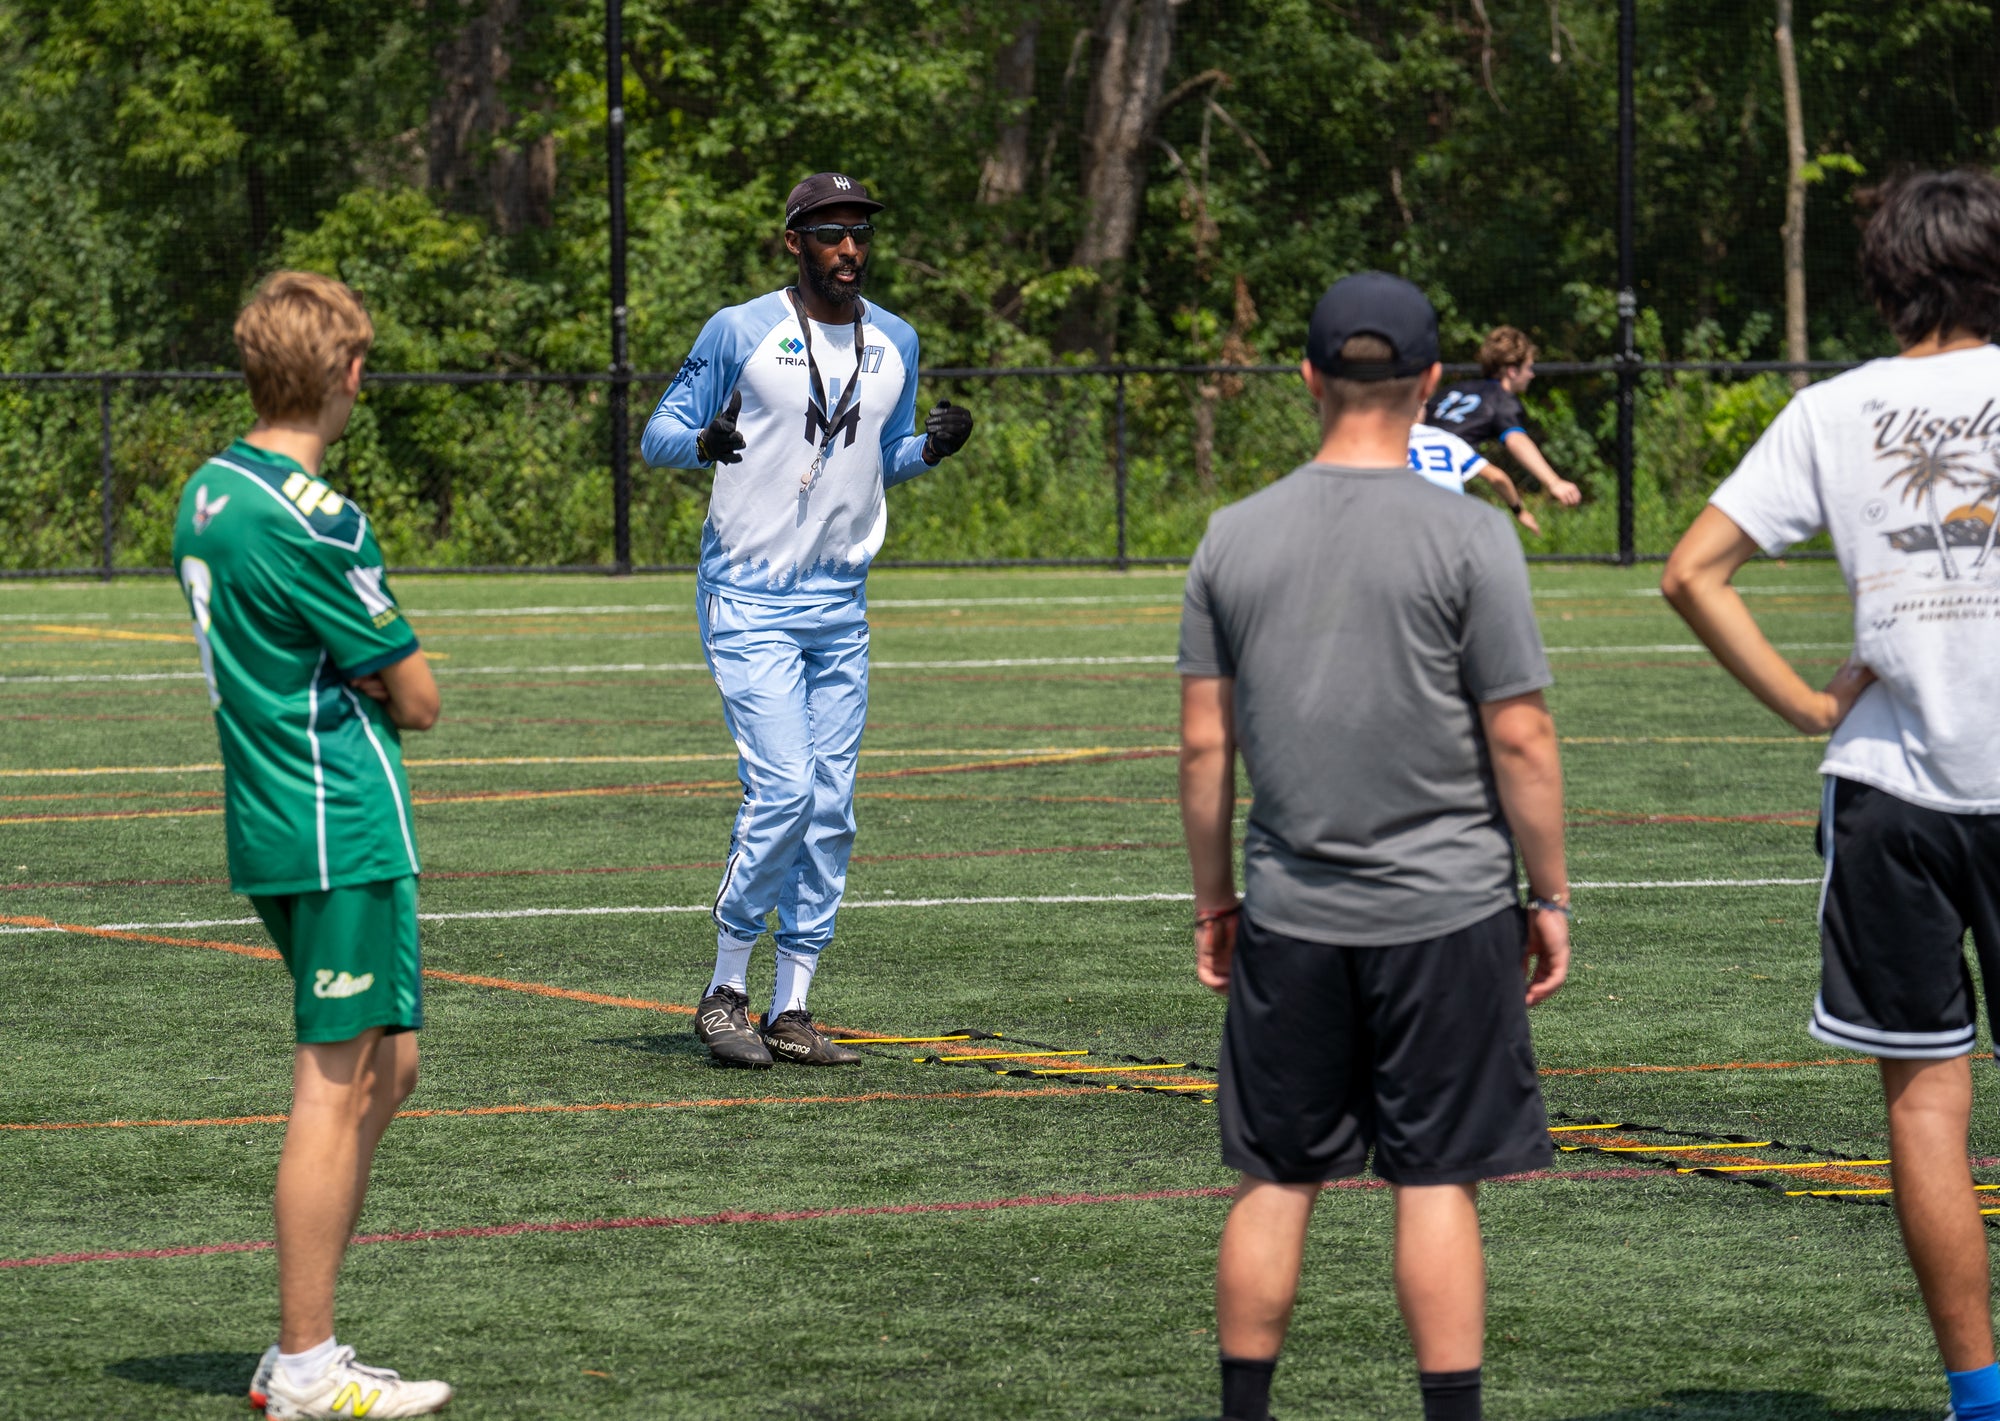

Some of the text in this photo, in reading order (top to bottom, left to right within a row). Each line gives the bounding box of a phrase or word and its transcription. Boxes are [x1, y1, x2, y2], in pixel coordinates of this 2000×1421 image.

[776, 357, 807, 367] TRIA
[861, 345, 886, 374] 17
[763, 1035, 811, 1055] new balance
[331, 1381, 381, 1418] N
